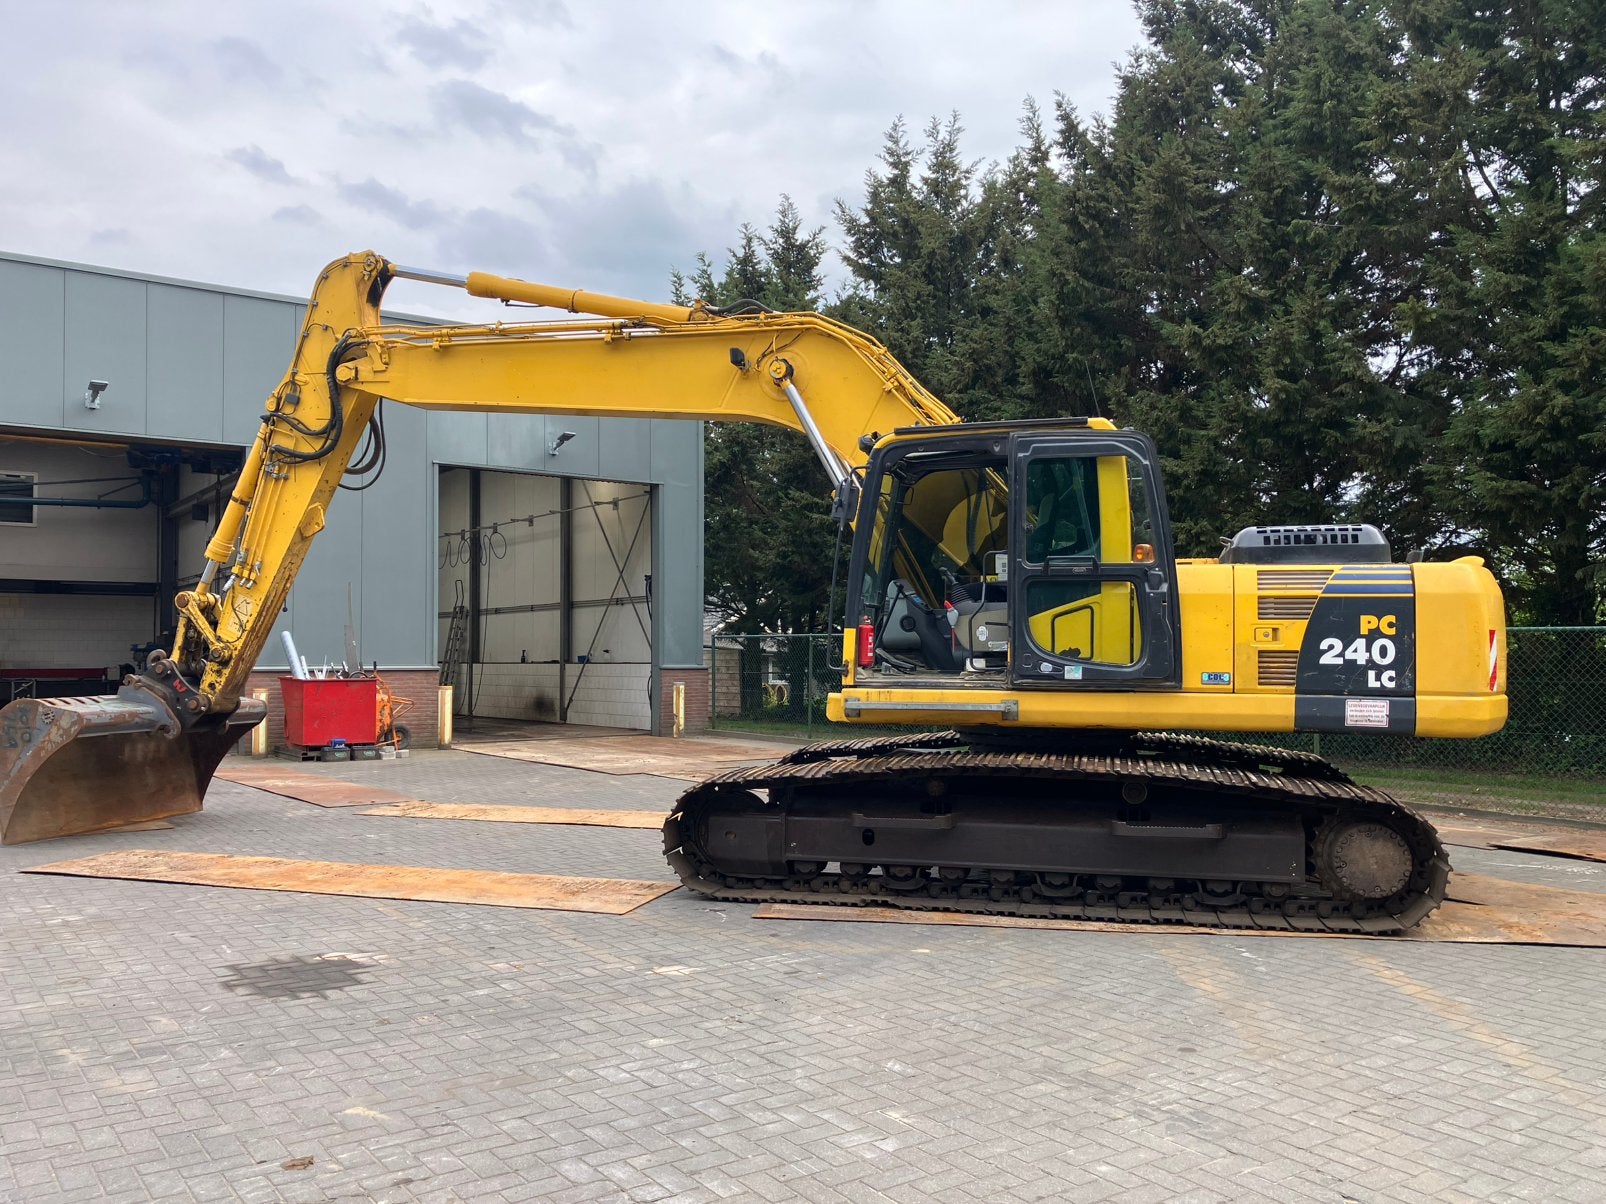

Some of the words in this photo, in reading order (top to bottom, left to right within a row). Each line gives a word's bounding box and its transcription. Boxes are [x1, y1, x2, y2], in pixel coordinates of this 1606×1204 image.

[1360, 615, 1396, 635] PC
[1319, 638, 1396, 665] 240
[1368, 670, 1396, 688] LC
